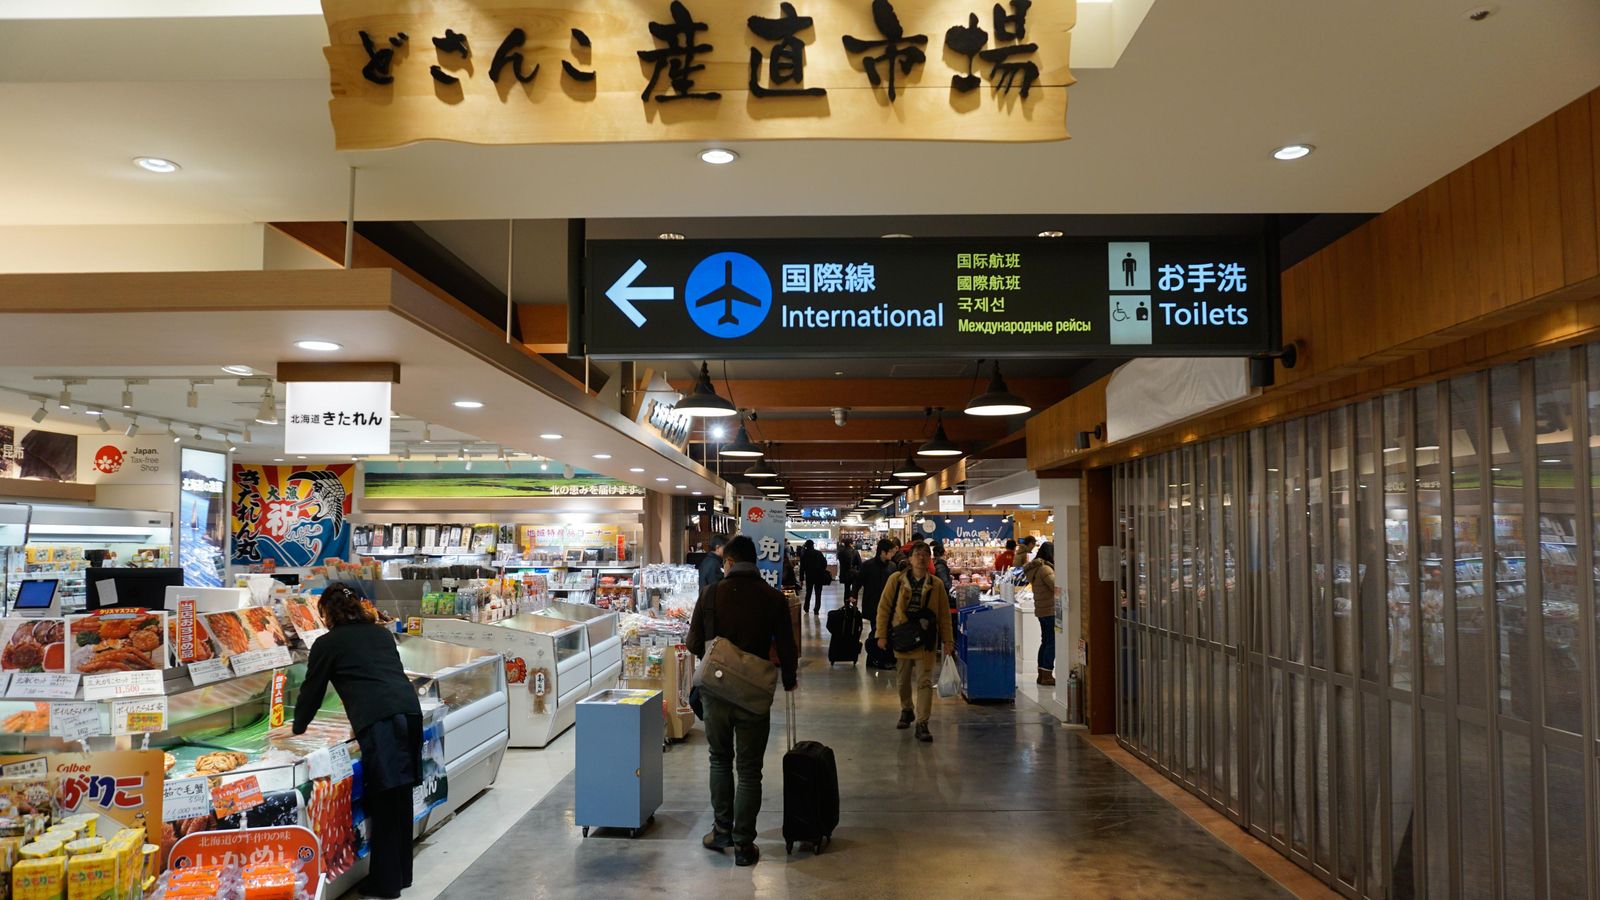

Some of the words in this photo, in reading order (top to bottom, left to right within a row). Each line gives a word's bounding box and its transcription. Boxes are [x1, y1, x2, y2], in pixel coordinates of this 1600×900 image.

[957, 253, 1021, 269] 国际航班
[781, 262, 876, 294] 国際線
[957, 275, 1021, 291] 國際航班
[1157, 262, 1248, 293] お手洗
[957, 297, 1006, 312] 국제선
[781, 303, 944, 328] International
[1158, 302, 1249, 326] Toilets
[958, 319, 1054, 335] Международные
[1056, 320, 1092, 333] рейсы
[322, 411, 383, 426] きたれん
[130, 456, 159, 464] Tax-free
[140, 464, 159, 472] Shop
[236, 470, 261, 561] きたれん丸
[56, 763, 91, 773] Calbee
[199, 831, 291, 847] 北海道の手作りの味
